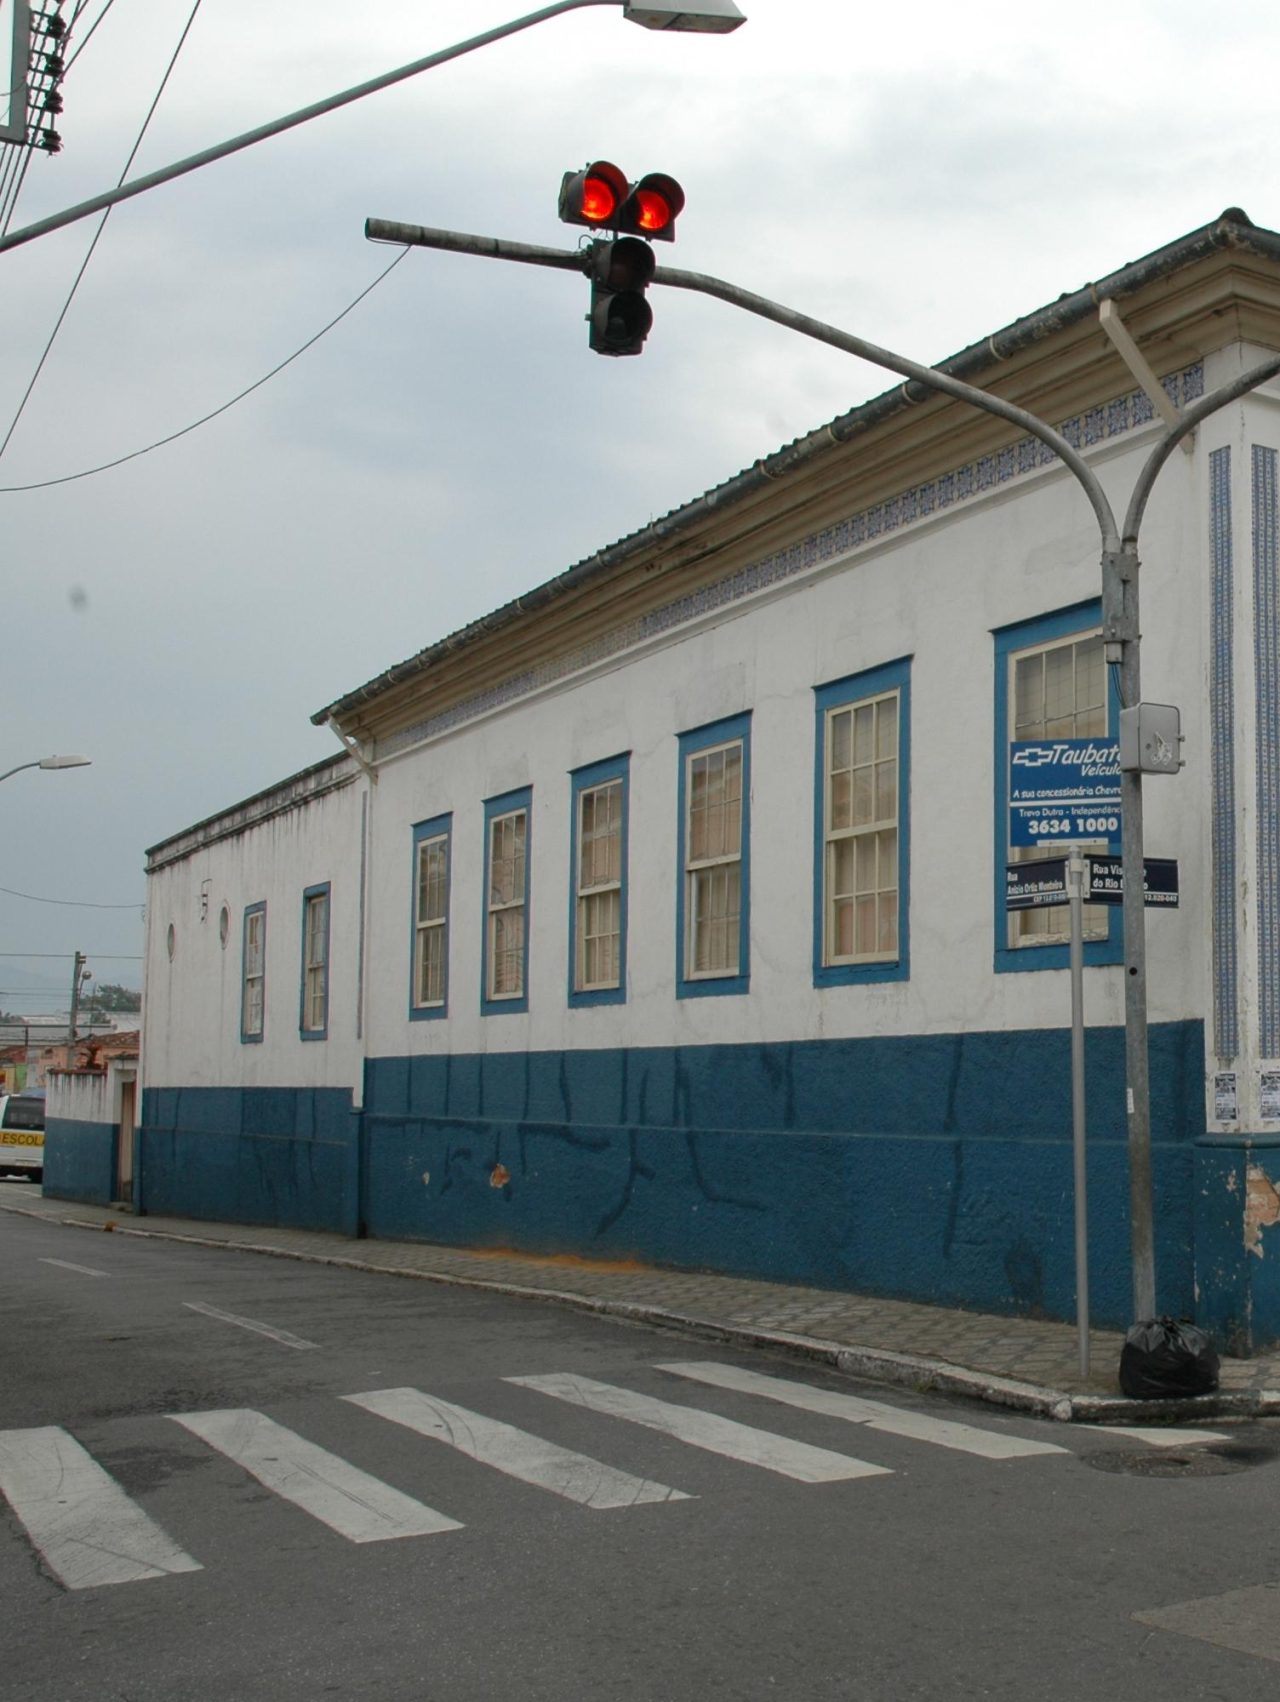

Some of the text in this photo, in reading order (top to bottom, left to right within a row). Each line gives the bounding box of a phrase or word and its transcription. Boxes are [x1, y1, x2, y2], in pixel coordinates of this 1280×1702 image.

[1081, 763, 1122, 777] Veículo
[1021, 790, 1035, 798] sua
[1028, 817, 1119, 834] 3634 1000
[1093, 863, 1109, 875] Rua
[1092, 878, 1104, 888] do
[1104, 878, 1119, 889] Rio
